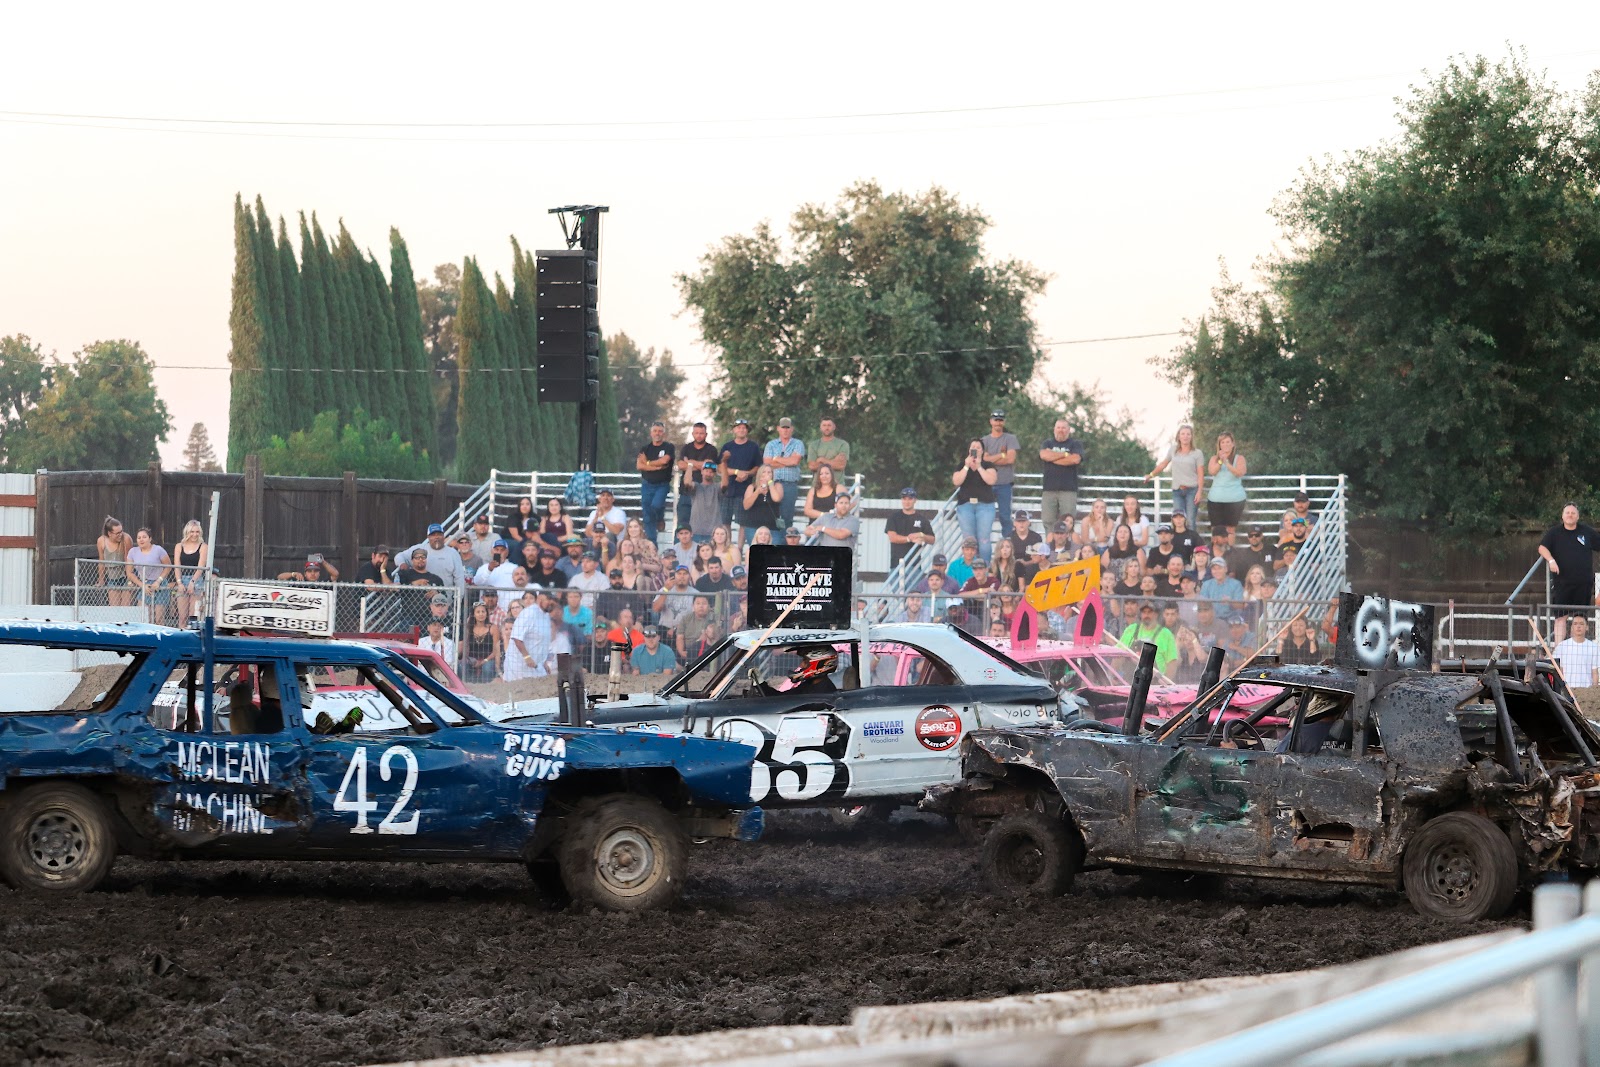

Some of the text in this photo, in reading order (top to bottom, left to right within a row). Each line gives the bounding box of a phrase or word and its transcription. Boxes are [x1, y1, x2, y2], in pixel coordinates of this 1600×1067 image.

[766, 573, 796, 586] MAN
[1035, 568, 1090, 602] 777
[226, 589, 322, 605] Pizza Guys
[766, 587, 832, 597] BARBESHOP
[224, 614, 328, 631] 668-8888
[1355, 595, 1422, 664] 65
[863, 720, 904, 730] CANEVARI
[863, 728, 904, 736] BROTHERS
[503, 733, 566, 758] PIZZA
[870, 736, 899, 744] Woodland
[178, 741, 270, 784] MCLEAN
[506, 754, 565, 780] GUYS
[333, 745, 420, 834] 42
